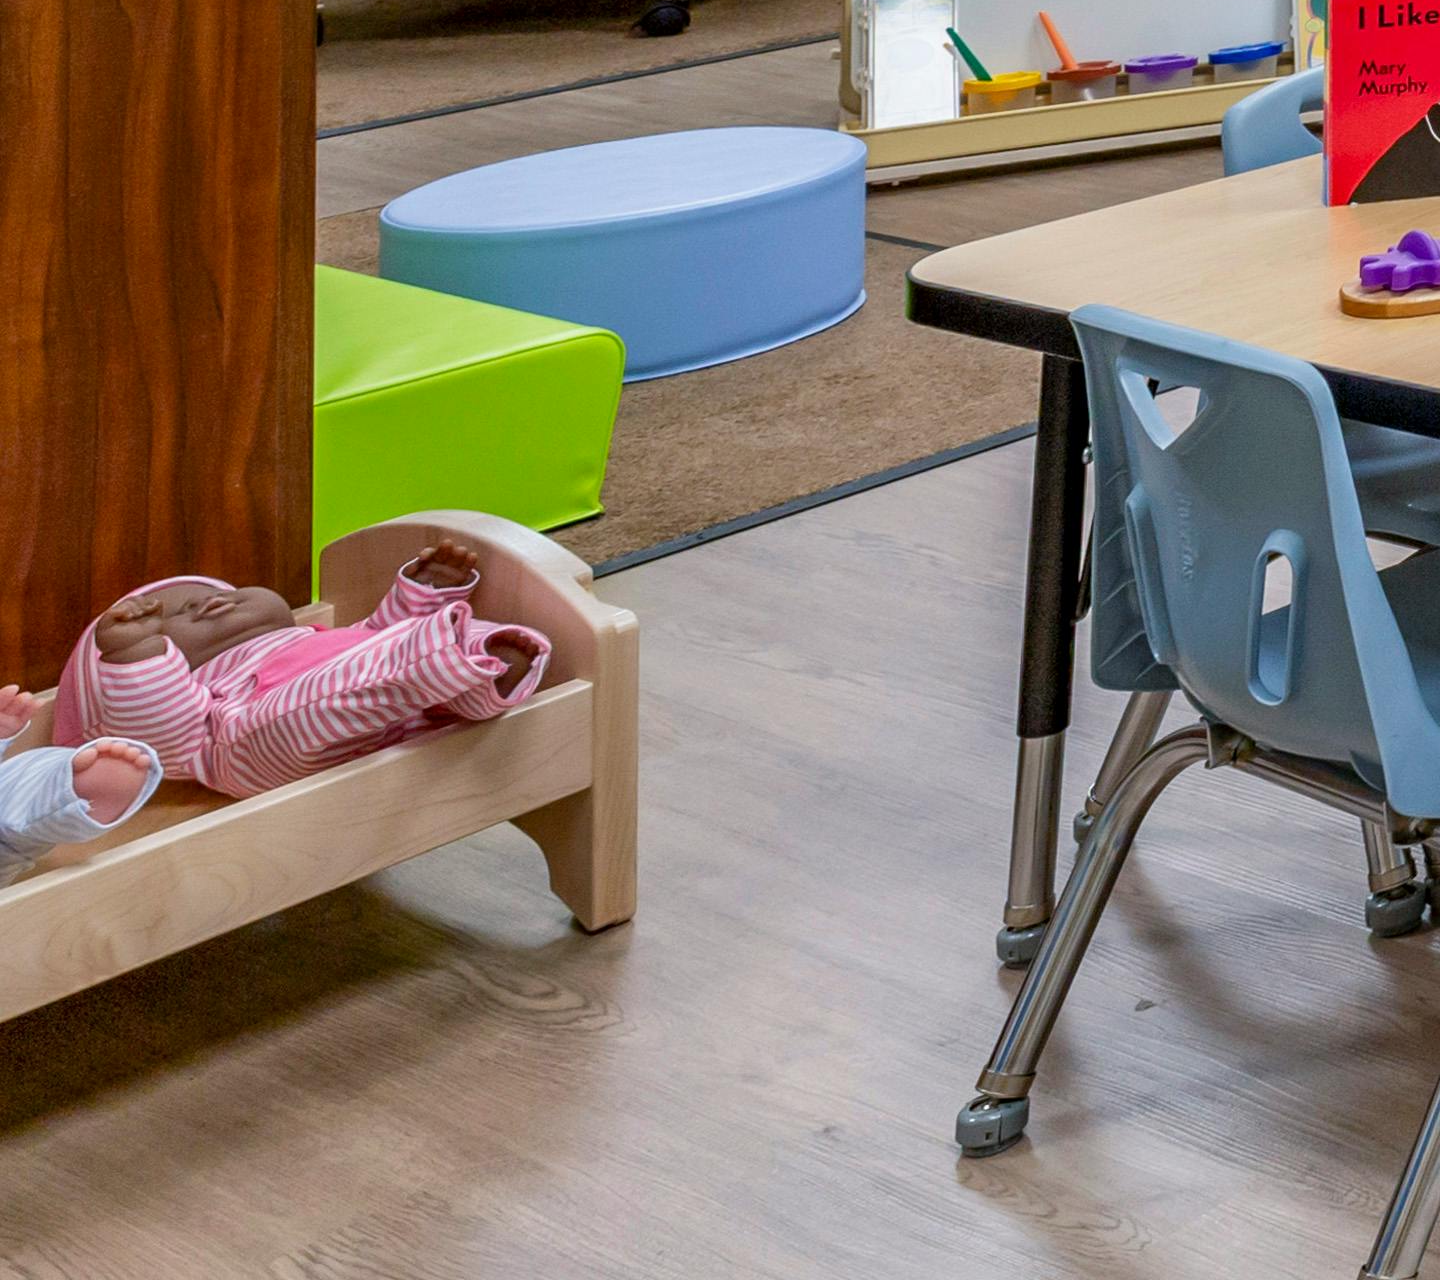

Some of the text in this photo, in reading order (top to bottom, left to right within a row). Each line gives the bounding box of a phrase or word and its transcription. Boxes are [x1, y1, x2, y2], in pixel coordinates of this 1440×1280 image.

[1358, 6, 1365, 29] I
[1378, 1, 1440, 28] Like
[1359, 60, 1406, 77] Mary
[1359, 77, 1428, 96] Murphy
